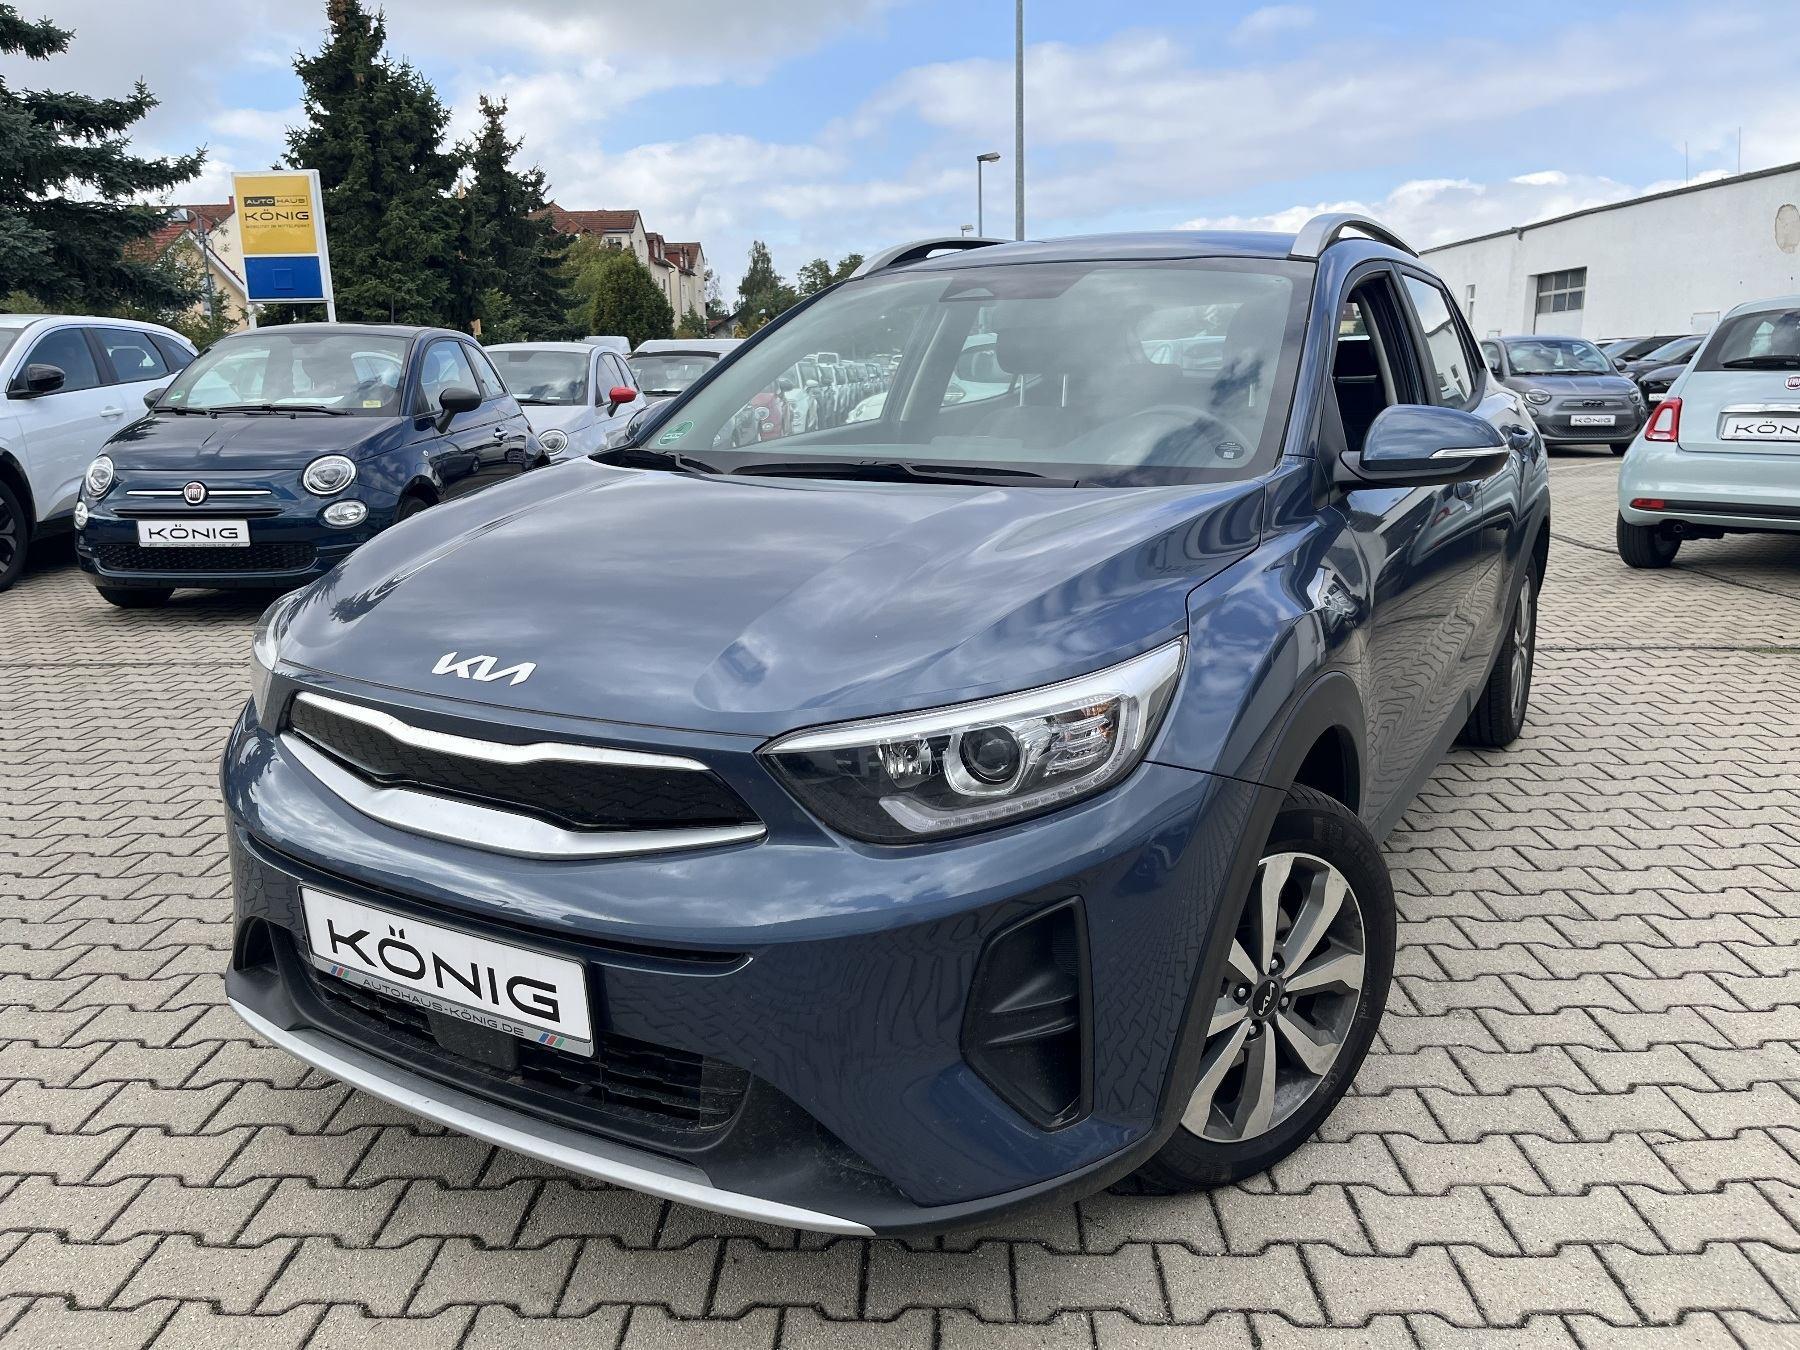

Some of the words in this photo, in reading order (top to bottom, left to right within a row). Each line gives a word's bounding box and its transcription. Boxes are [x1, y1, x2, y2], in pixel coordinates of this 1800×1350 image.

[244, 209, 309, 221] KÖNIG
[1574, 416, 1611, 424] KÖNIG
[188, 488, 201, 498] FIAT
[148, 524, 238, 540] KÖNIG
[327, 918, 561, 1023] KÖNIG
[363, 979, 525, 1036] AUTOHAUS-KÖNIG.DE
